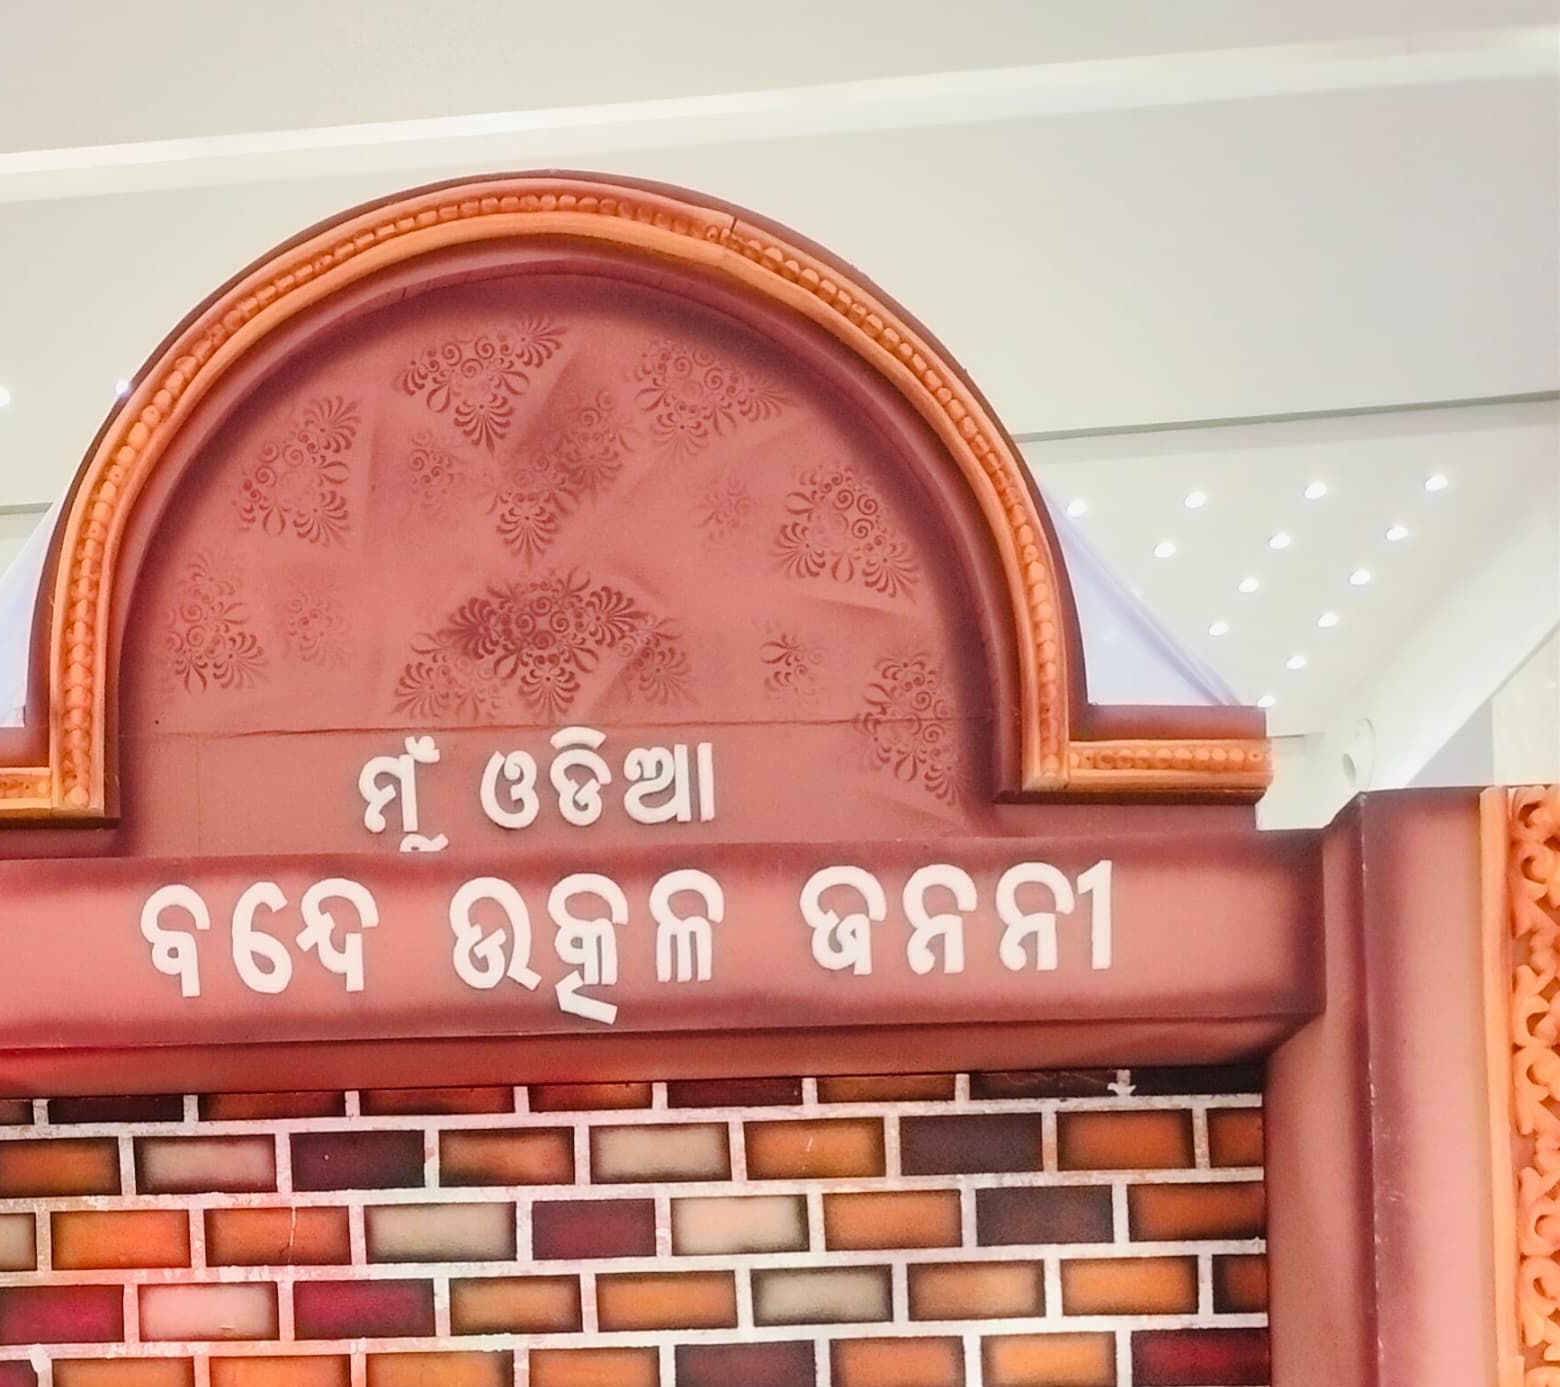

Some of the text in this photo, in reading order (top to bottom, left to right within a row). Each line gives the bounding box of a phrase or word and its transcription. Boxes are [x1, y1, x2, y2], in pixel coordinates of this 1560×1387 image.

[480, 727, 715, 830] ଓଡିଆ
[140, 878, 379, 998] ବନ୍ଦେ
[800, 860, 1113, 976] ଜନନୀ
